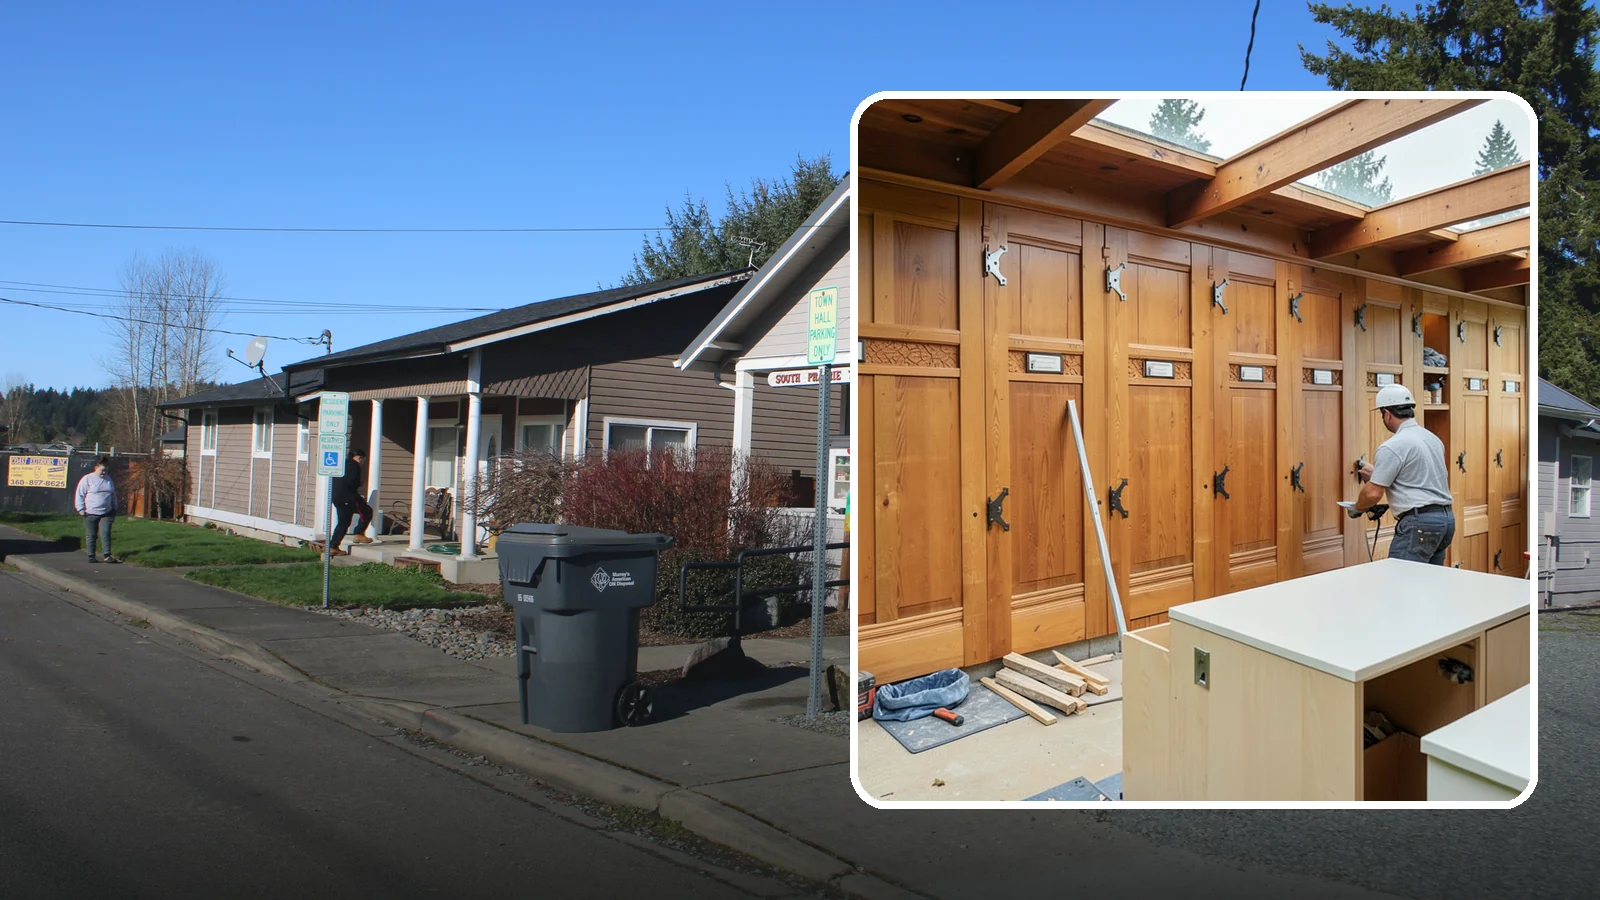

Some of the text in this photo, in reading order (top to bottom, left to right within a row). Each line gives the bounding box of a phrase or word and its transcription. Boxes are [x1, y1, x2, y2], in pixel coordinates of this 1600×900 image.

[815, 295, 833, 307] TOWN
[815, 312, 831, 324] HALL
[810, 326, 836, 341] PARKING
[814, 344, 830, 357] ONLY
[775, 373, 801, 384] SOUTH
[807, 371, 841, 382] PRIE
